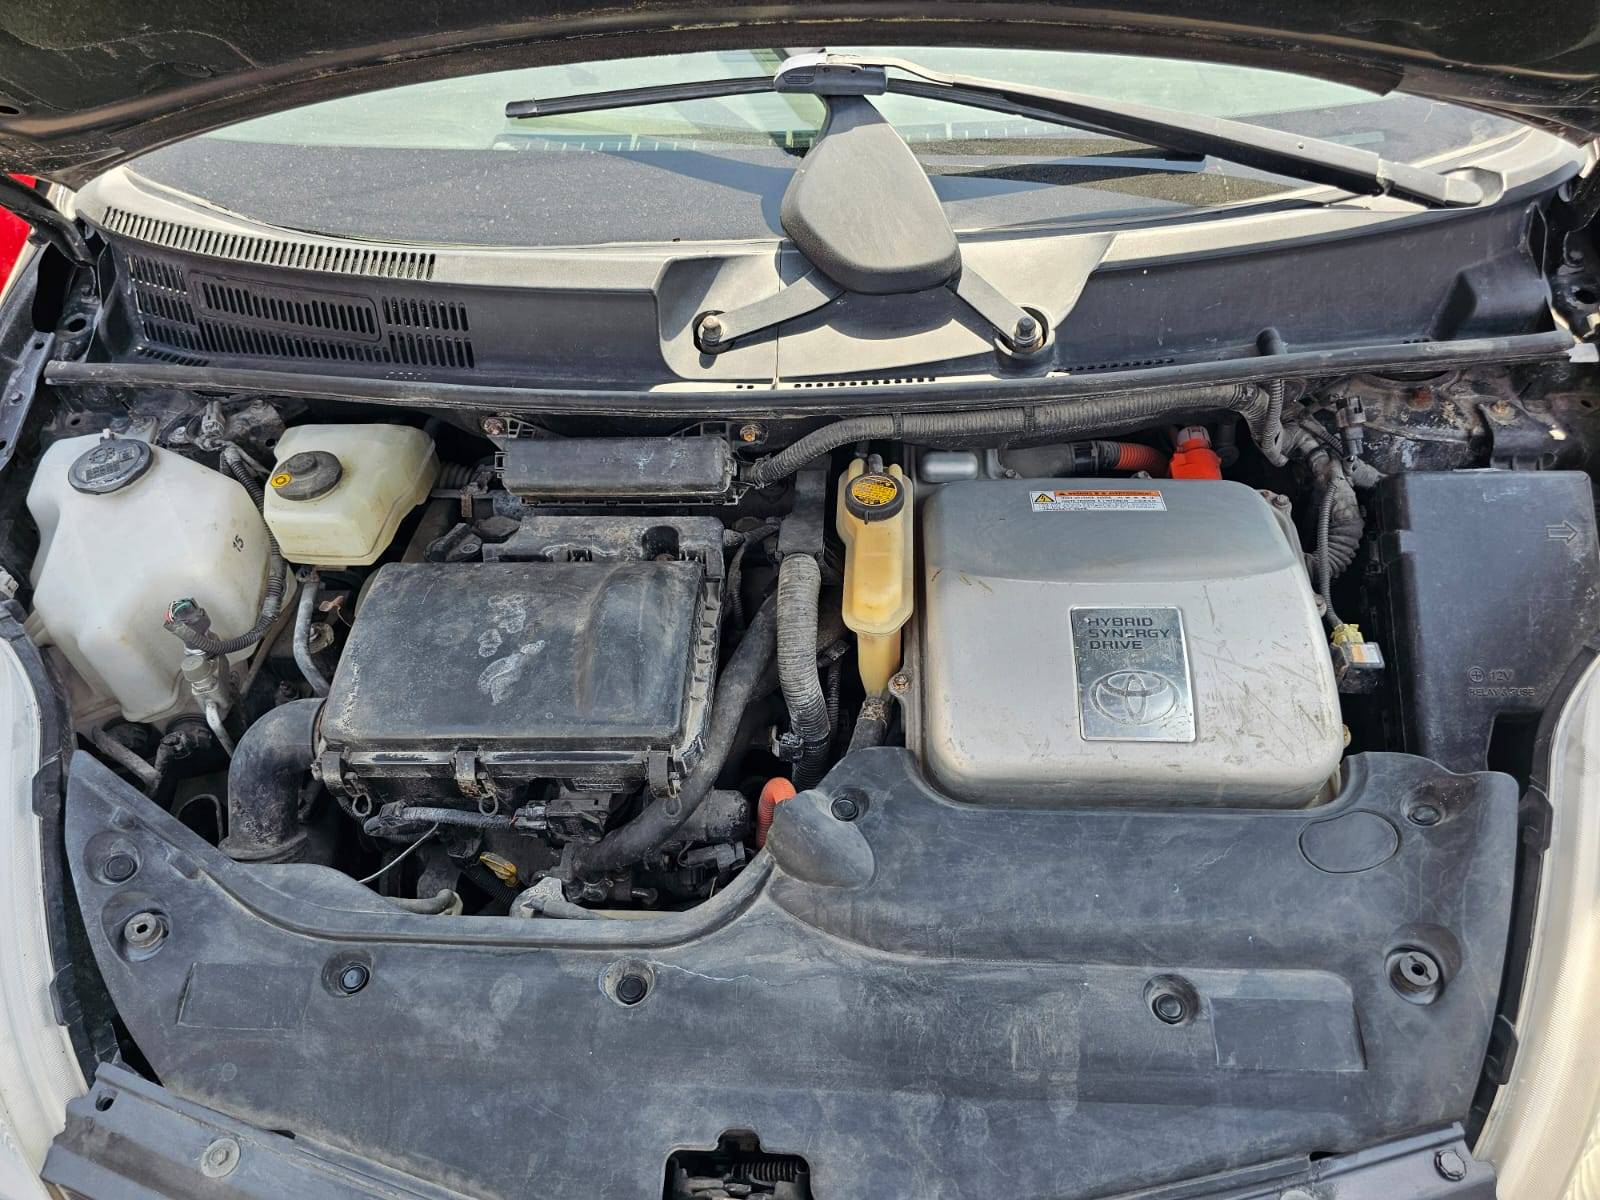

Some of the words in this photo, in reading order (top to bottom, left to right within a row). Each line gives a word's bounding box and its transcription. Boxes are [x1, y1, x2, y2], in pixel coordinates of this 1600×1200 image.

[1087, 617, 1153, 627] HYBRID
[1088, 628, 1170, 638] SYNERGY
[1089, 640, 1143, 650] DRIVE
[1488, 668, 1515, 681] 12V
